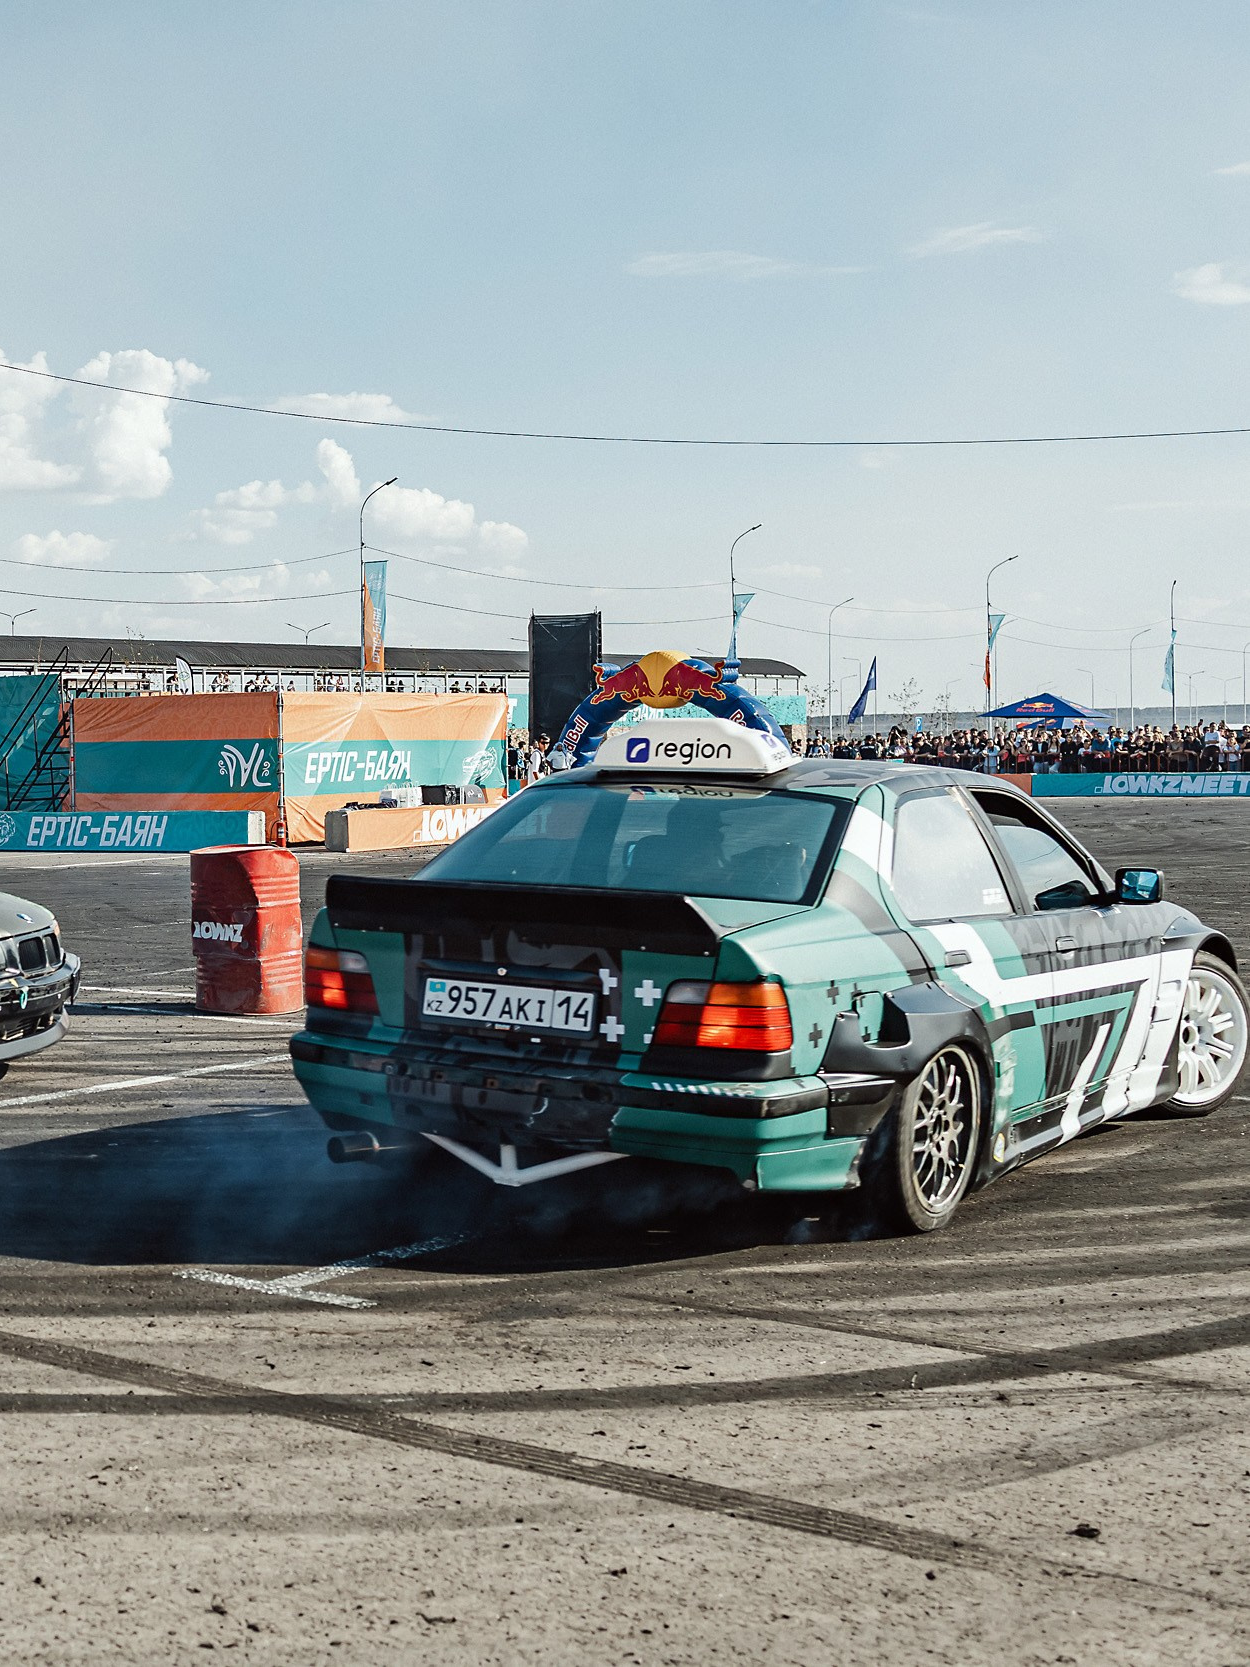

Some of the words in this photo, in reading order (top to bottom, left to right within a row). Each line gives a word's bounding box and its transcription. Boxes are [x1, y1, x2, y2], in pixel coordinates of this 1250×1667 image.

[565, 714, 589, 744] Bull
[304, 749, 412, 785] ЕРТІС-БАЯН
[655, 738, 732, 765] region
[26, 814, 169, 847] ЕРТІС-БАЯН
[426, 999, 443, 1013] KZ
[448, 985, 497, 1017] 957
[557, 995, 589, 1028] 14
